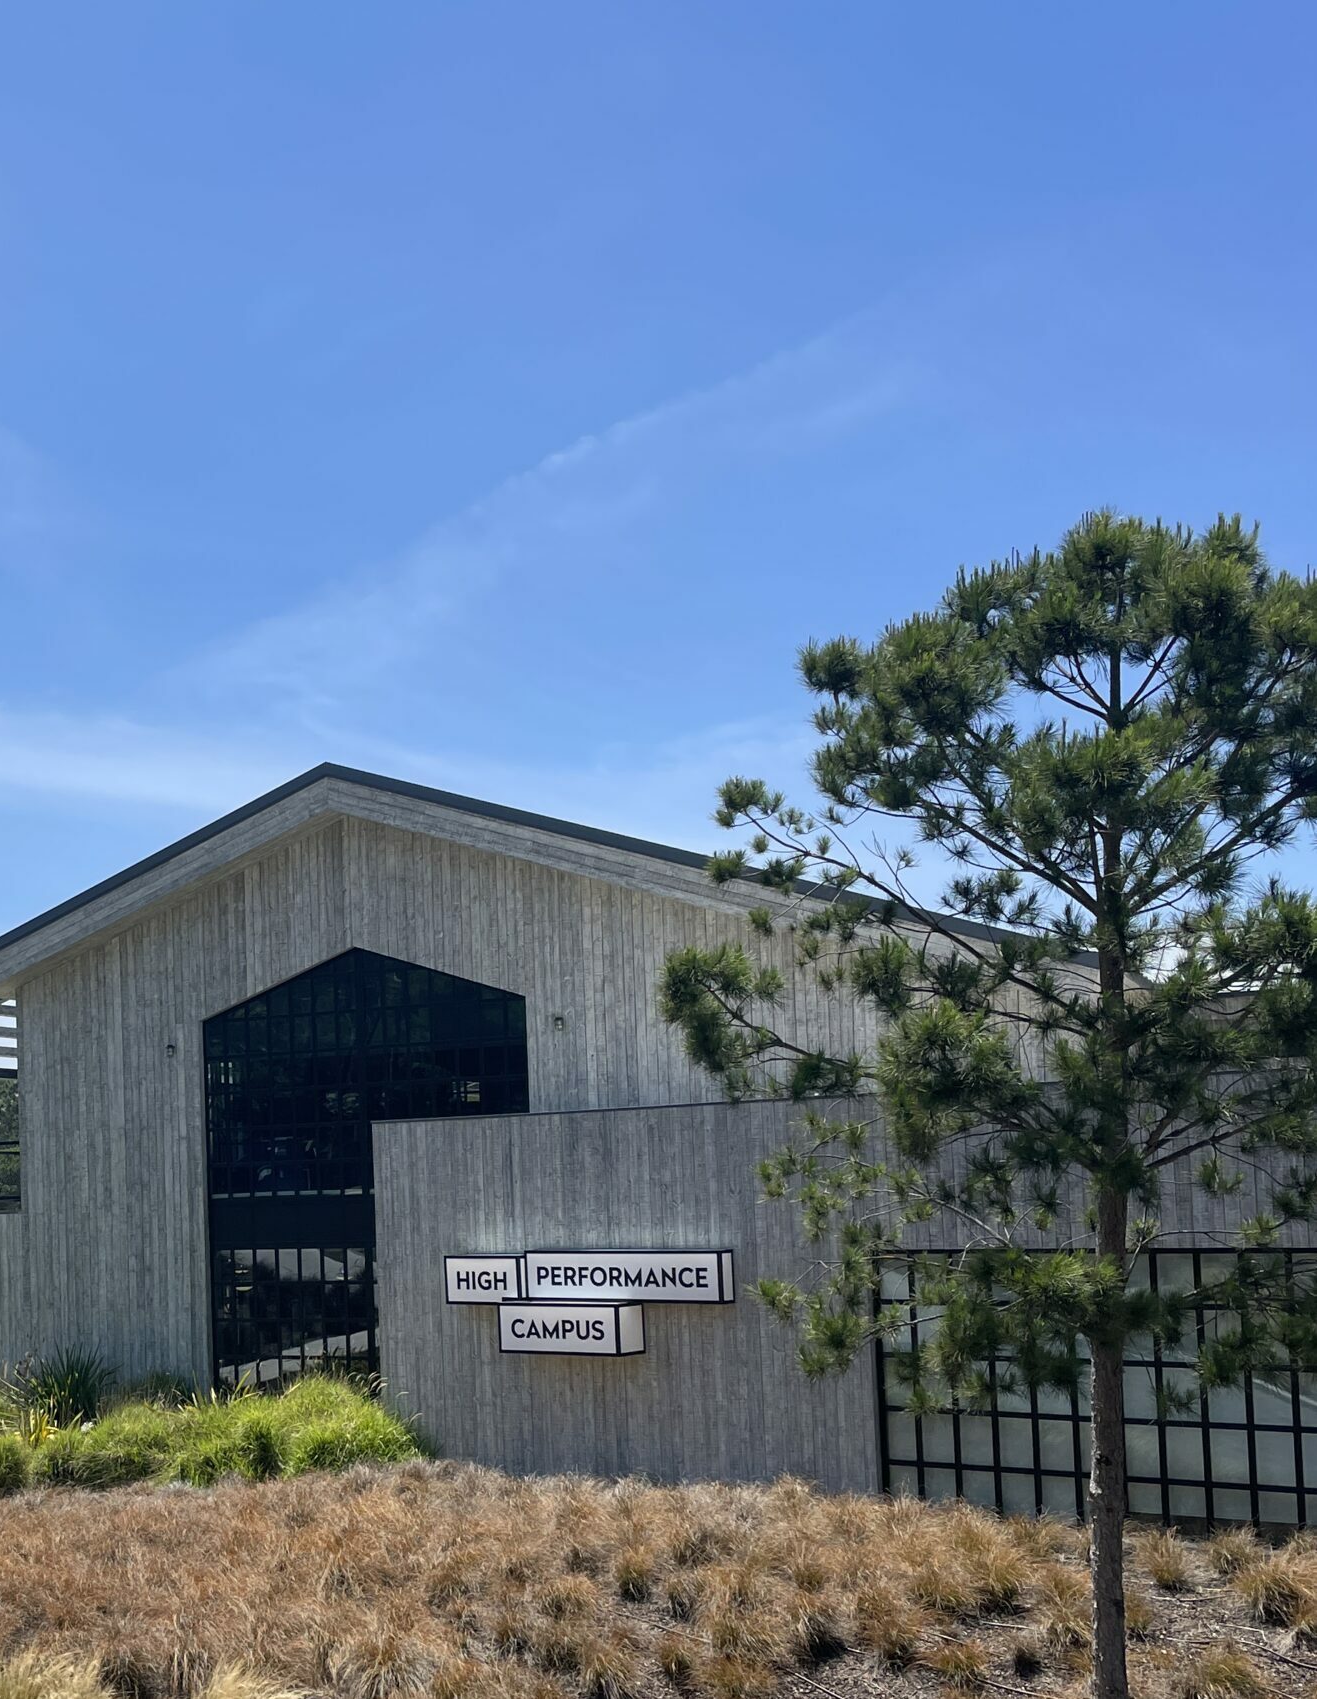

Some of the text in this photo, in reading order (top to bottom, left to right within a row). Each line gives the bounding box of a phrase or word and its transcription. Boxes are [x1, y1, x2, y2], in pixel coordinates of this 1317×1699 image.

[456, 1266, 709, 1291] HIGH PERFORMANCE
[510, 1318, 605, 1341] CAMPUS
